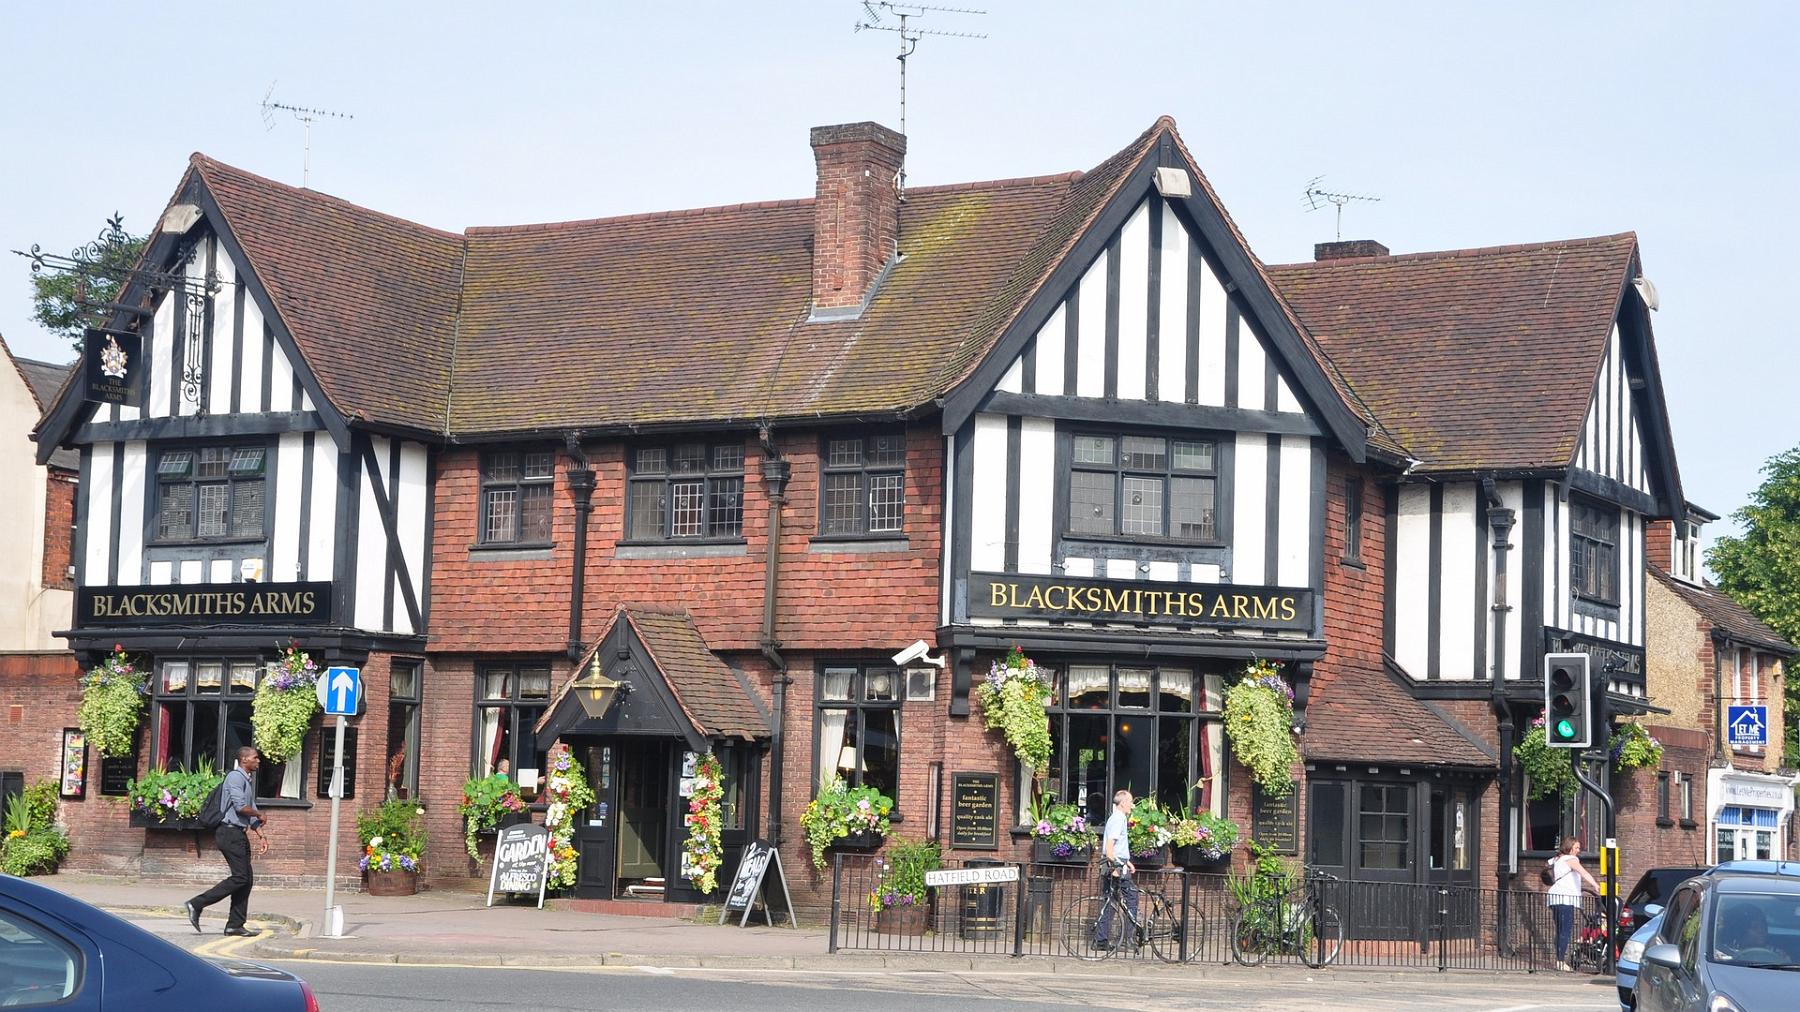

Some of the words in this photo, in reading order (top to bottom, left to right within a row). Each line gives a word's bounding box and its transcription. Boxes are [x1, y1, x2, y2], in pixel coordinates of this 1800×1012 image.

[93, 592, 245, 616] BLACKSMITHS
[249, 591, 315, 614] ARMS
[989, 583, 1204, 617] BLACKSMITHS
[1210, 594, 1296, 621] ARMS
[1735, 724, 1748, 736] LET
[1749, 724, 1760, 736] ME
[499, 834, 547, 863] GARDEN
[739, 855, 766, 878] MEALS
[500, 872, 537, 883] ALFRESCO
[500, 881, 531, 891] DINING
[928, 871, 980, 884] HATFIELD
[985, 869, 1016, 880] ROAD
